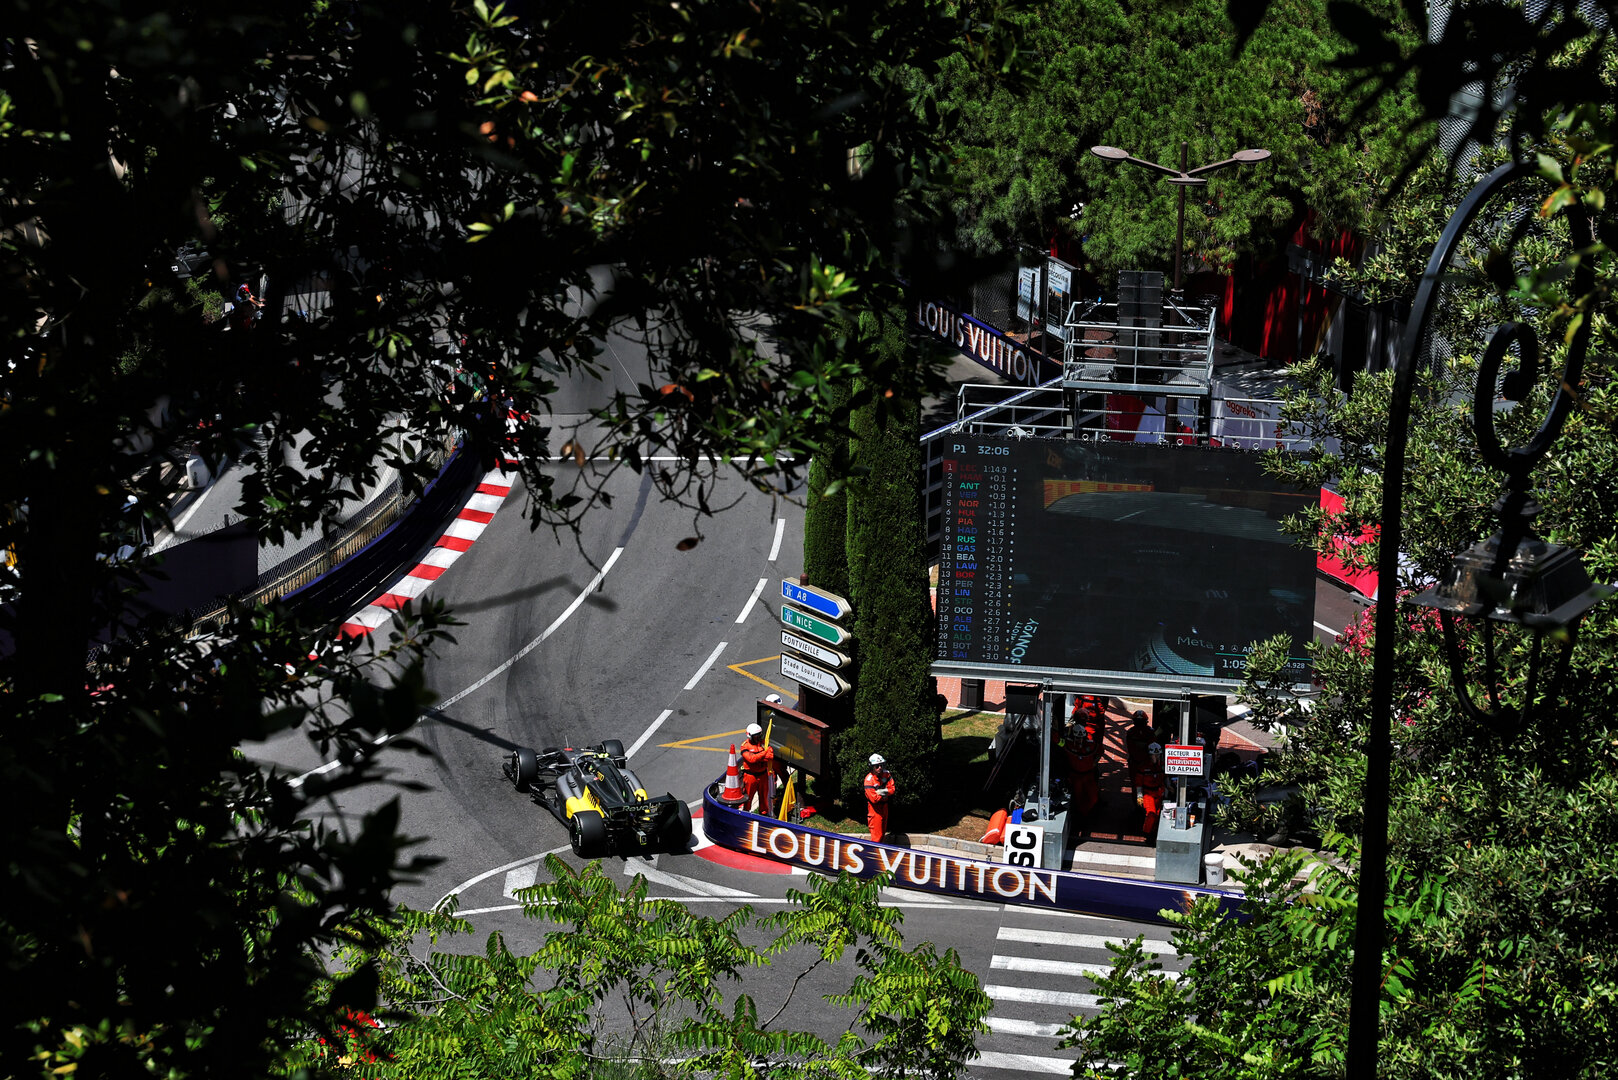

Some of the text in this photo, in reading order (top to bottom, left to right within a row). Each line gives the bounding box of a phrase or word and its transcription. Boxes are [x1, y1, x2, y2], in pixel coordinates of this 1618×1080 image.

[918, 299, 1040, 387] LOUIS VUITTON
[1226, 400, 1255, 418] aggreko
[953, 444, 1010, 455] P1 32:06
[797, 590, 807, 602] A8
[796, 615, 813, 630] NICE
[784, 635, 820, 656] FONTVIEILLE
[1177, 636, 1214, 650] Meta
[784, 658, 799, 670] Stade
[801, 665, 815, 677] Louis
[1222, 659, 1246, 669] 1:05
[784, 667, 795, 677] Centre
[796, 673, 815, 687] Commercial
[1009, 831, 1036, 867] SC
[751, 821, 1057, 903] LOUIS VUITTON
